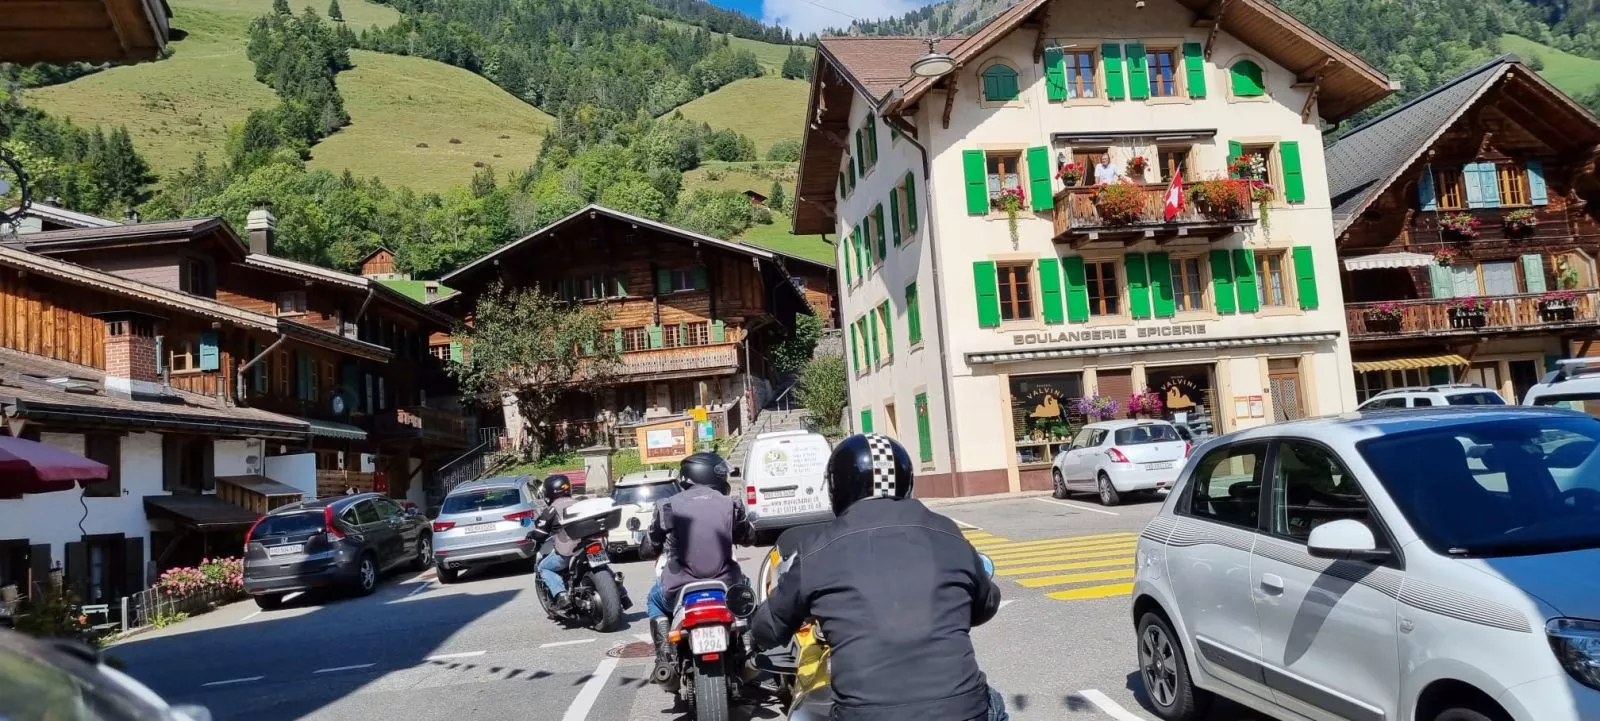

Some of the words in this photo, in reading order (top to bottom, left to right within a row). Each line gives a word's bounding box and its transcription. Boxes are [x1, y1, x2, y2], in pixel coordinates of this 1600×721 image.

[1013, 329, 1127, 345] BOULANGERIE
[1137, 325, 1206, 337] EPICERIE
[1160, 379, 1197, 390] VALVINI
[1026, 387, 1064, 399] VALVINI
[702, 629, 716, 638] NE
[699, 639, 722, 652] 1294
